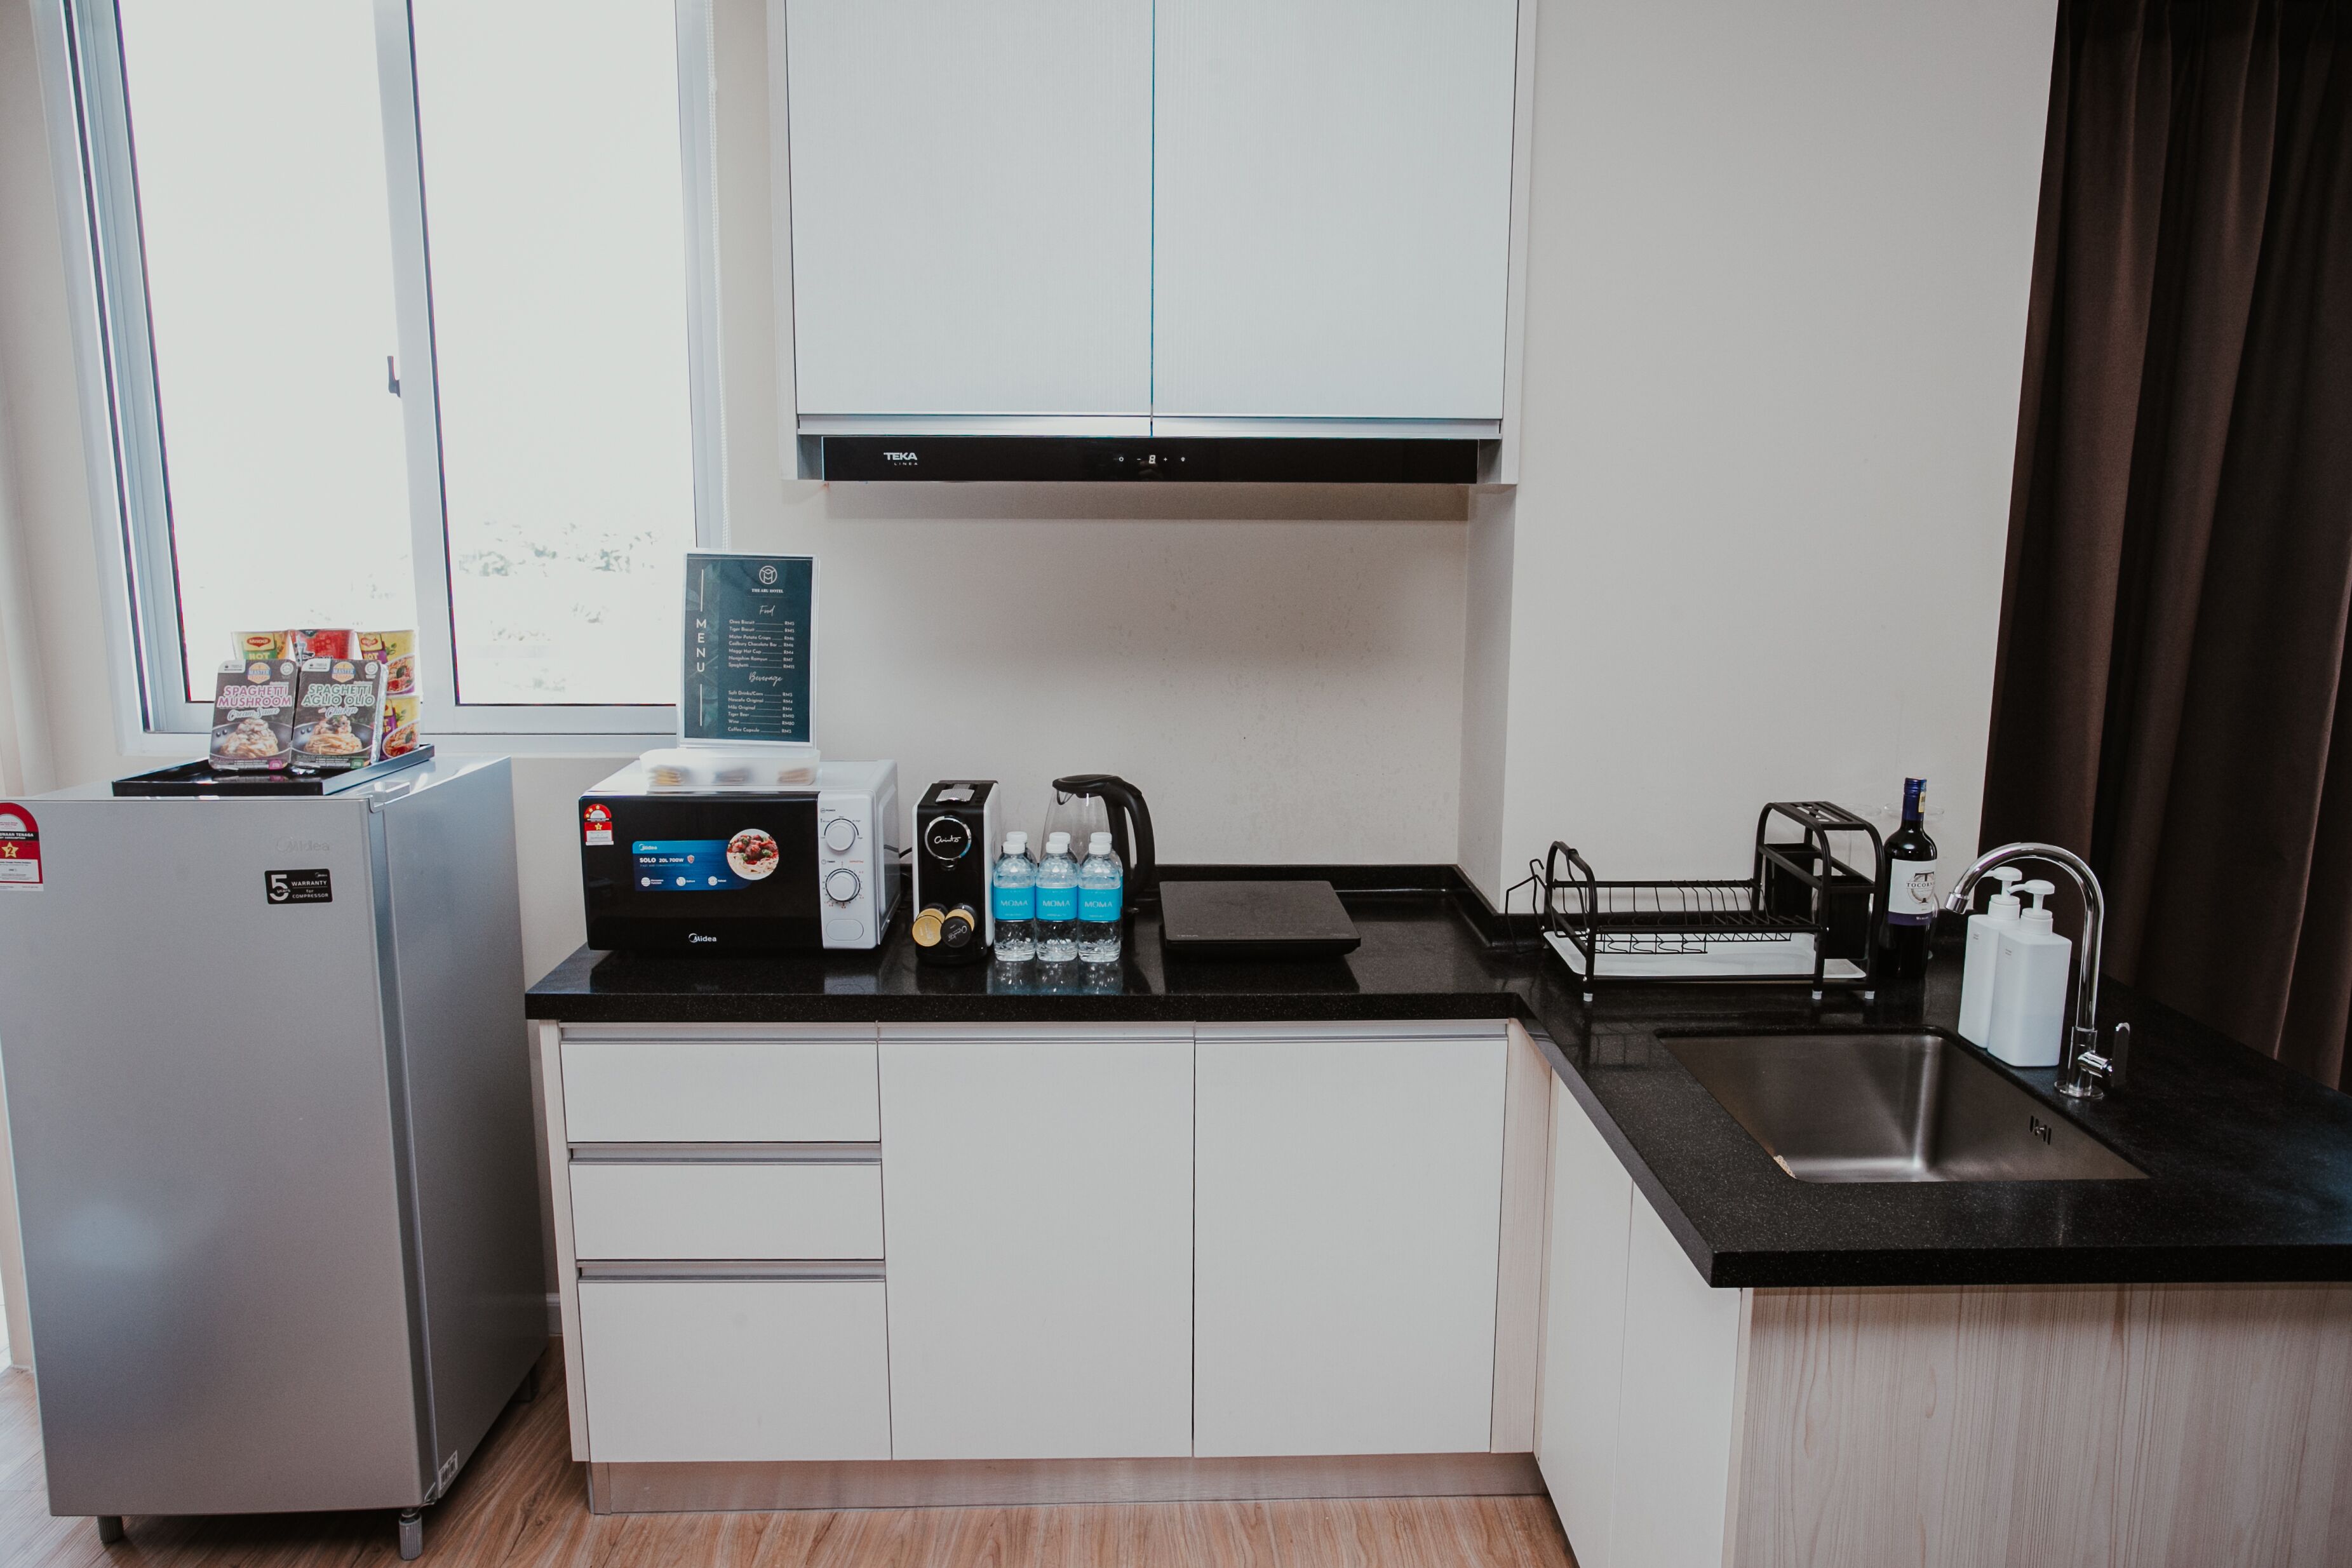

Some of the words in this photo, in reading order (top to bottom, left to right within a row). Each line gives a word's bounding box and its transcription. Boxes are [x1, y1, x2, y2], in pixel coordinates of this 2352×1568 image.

[759, 605, 775, 616] Food
[696, 619, 707, 672] MENU
[749, 671, 783, 687] Beverage
[225, 686, 288, 696] SPAGHETTI
[309, 685, 372, 695] SPAGHETTI
[218, 696, 292, 707] MUSHROOM
[302, 695, 342, 706] AGLIO
[344, 695, 375, 706] OLIO
[228, 710, 255, 720] Cream
[256, 707, 280, 718] Sauce
[326, 706, 358, 718] Chicken
[270, 874, 289, 901] 5
[689, 933, 717, 943] Midea
